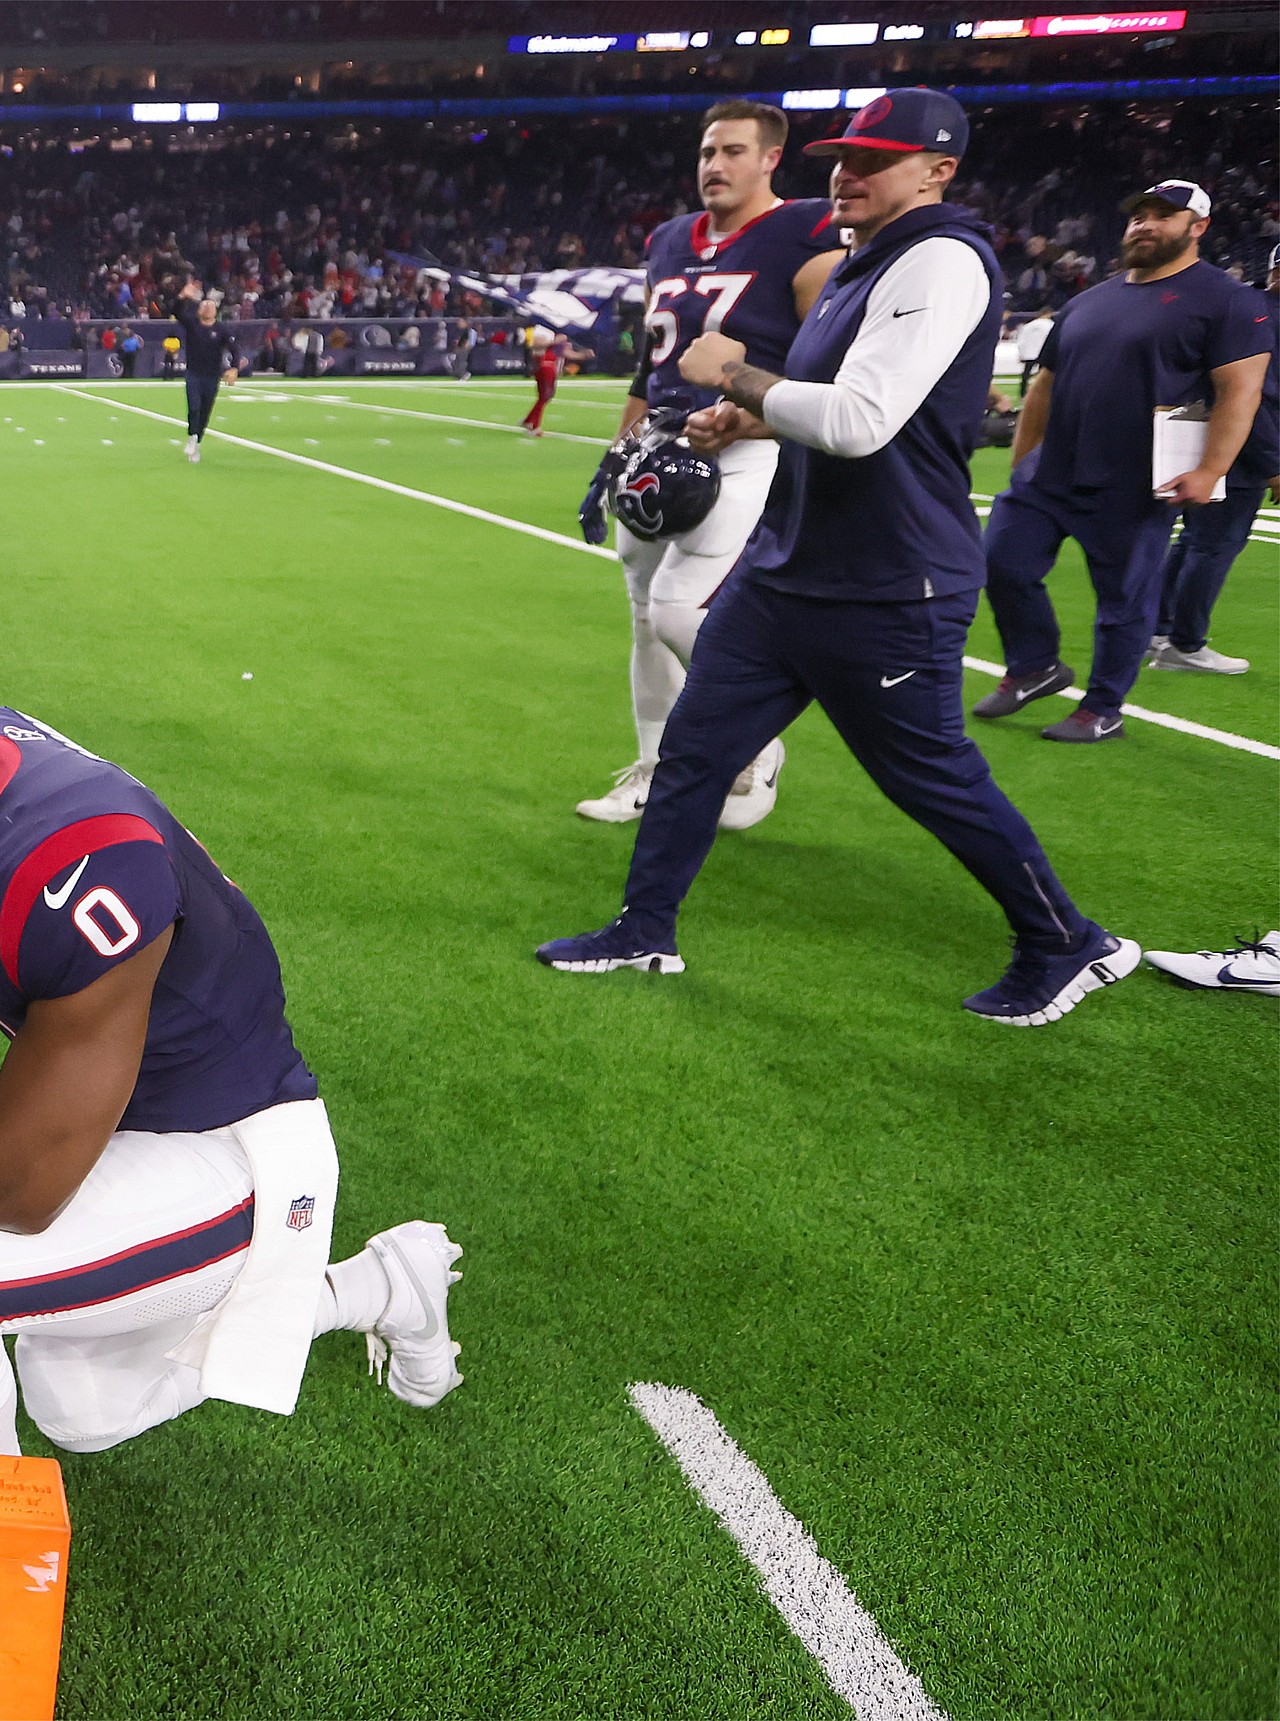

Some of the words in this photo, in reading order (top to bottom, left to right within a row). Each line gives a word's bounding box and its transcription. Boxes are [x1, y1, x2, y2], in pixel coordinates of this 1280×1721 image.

[646, 272, 758, 365] 67
[72, 886, 141, 957] 0
[290, 1210, 310, 1227] NFL
